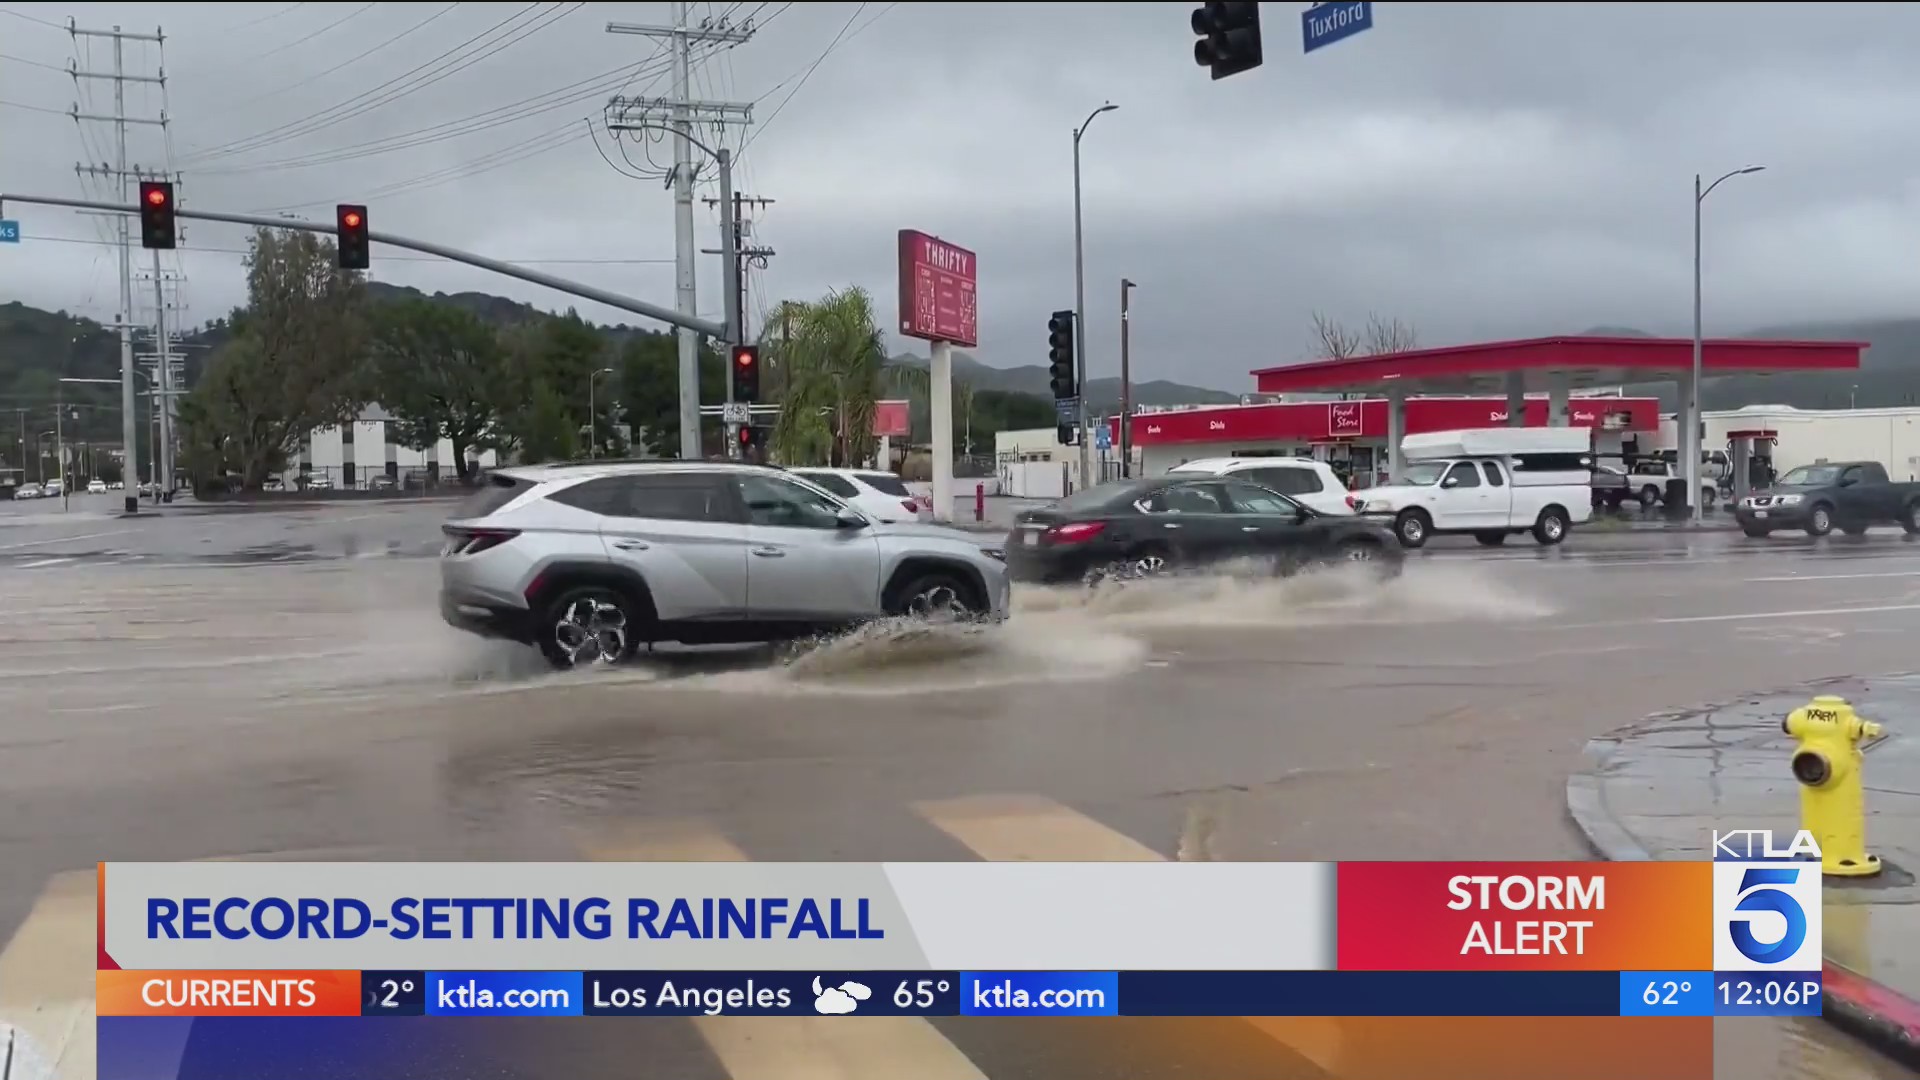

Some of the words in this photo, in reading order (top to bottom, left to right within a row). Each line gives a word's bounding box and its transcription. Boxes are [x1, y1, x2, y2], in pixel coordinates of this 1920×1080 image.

[1308, 2, 1363, 39] Tuxford
[925, 241, 968, 275] THRIFTY
[1333, 405, 1354, 418] Food
[1337, 416, 1358, 428] Store
